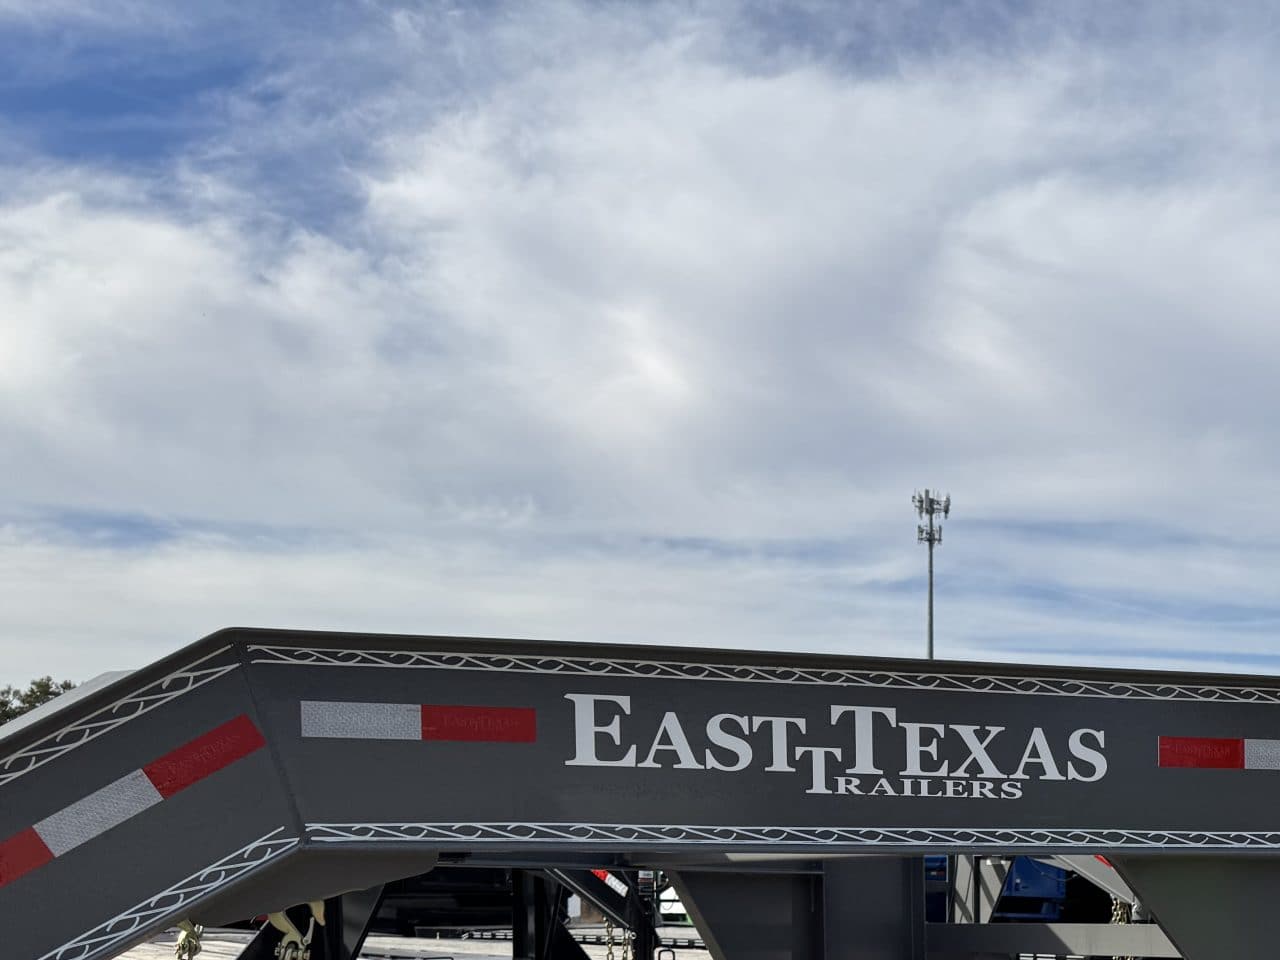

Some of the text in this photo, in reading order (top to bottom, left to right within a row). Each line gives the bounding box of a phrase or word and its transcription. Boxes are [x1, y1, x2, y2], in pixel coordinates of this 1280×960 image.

[564, 693, 1108, 782] EAST TEXAS
[795, 746, 1023, 800] TRAILERS
